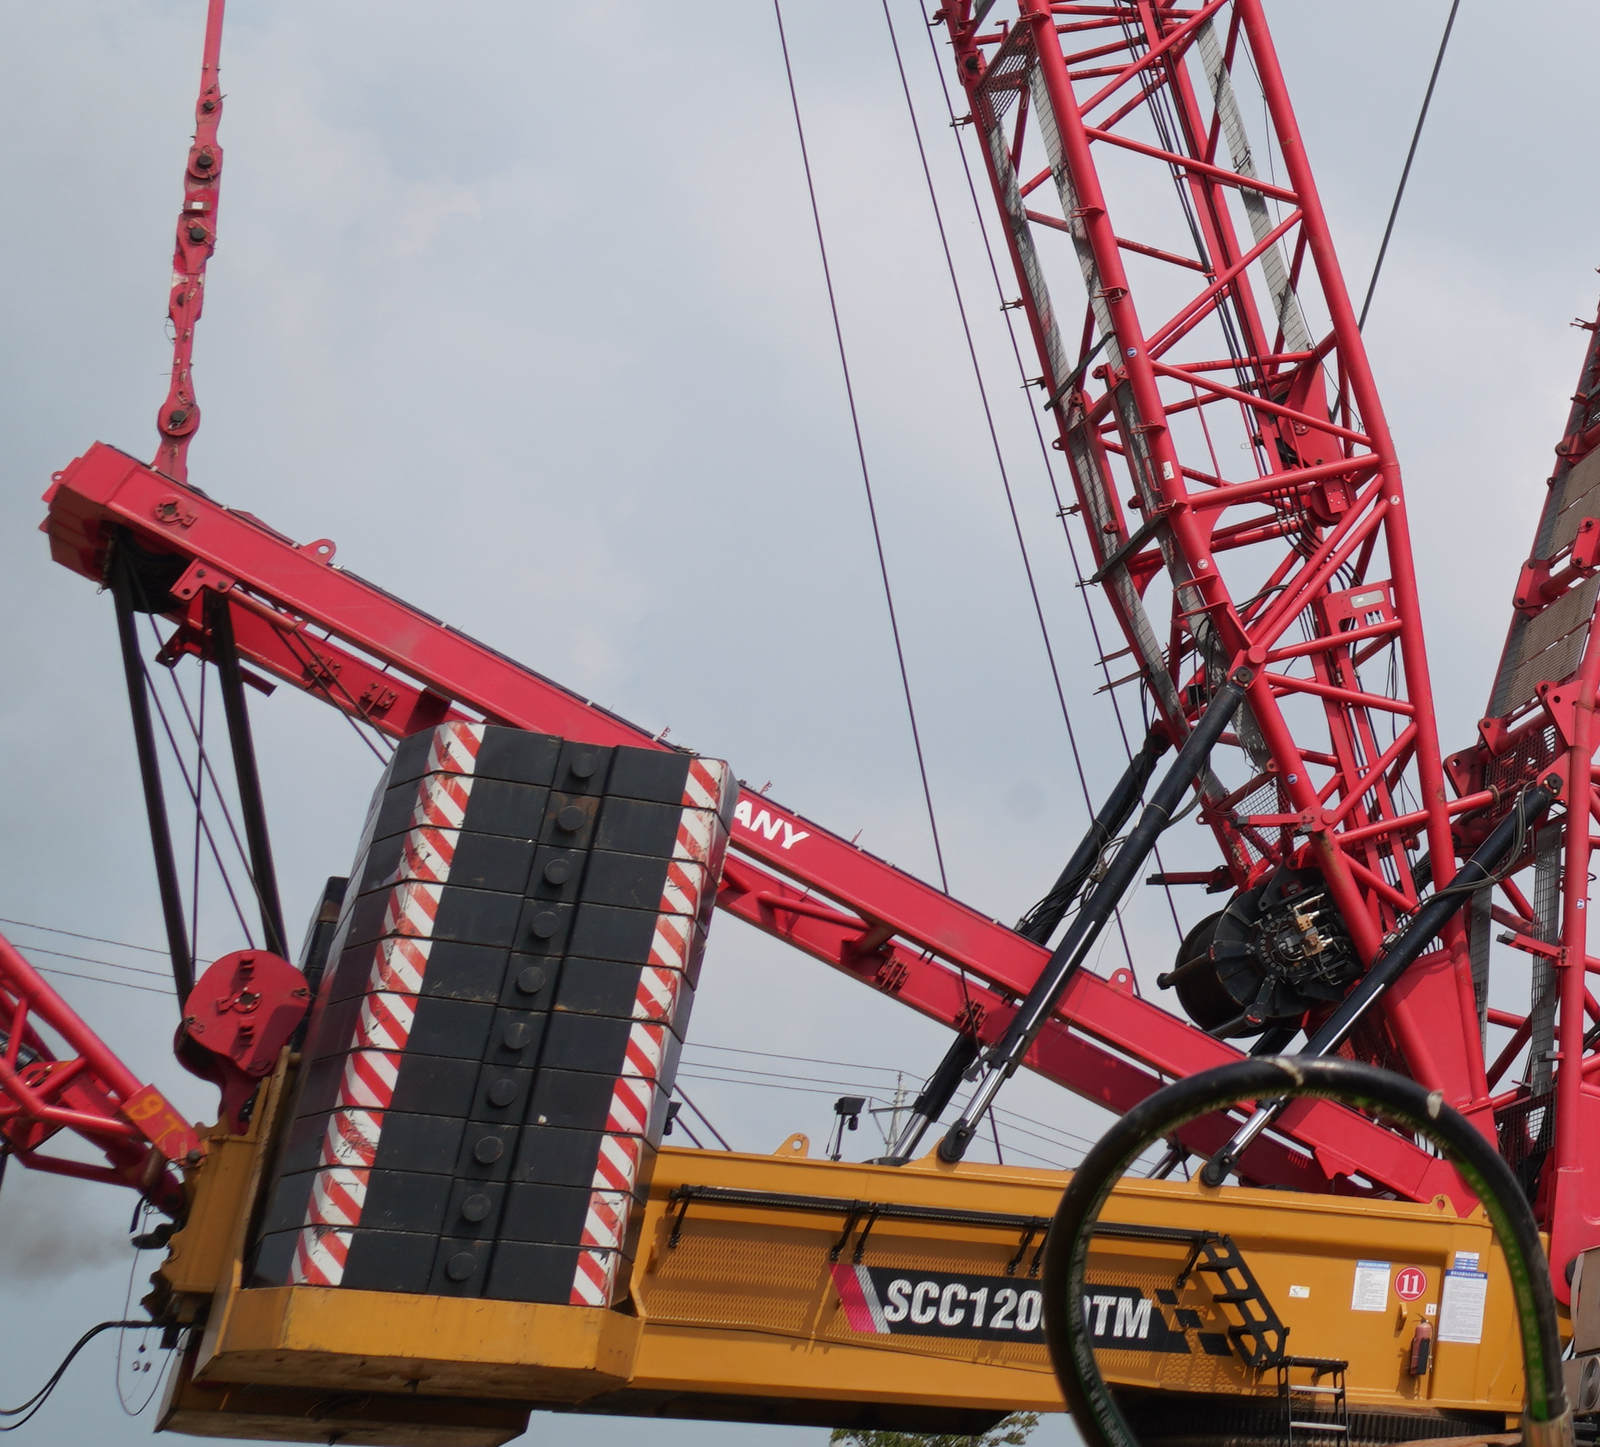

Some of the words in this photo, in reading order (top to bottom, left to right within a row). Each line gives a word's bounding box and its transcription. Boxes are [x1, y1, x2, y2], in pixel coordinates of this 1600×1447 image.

[734, 800, 810, 850] ANY
[1400, 1273, 1420, 1294] 11
[884, 1279, 1153, 1340] SCC120TM
